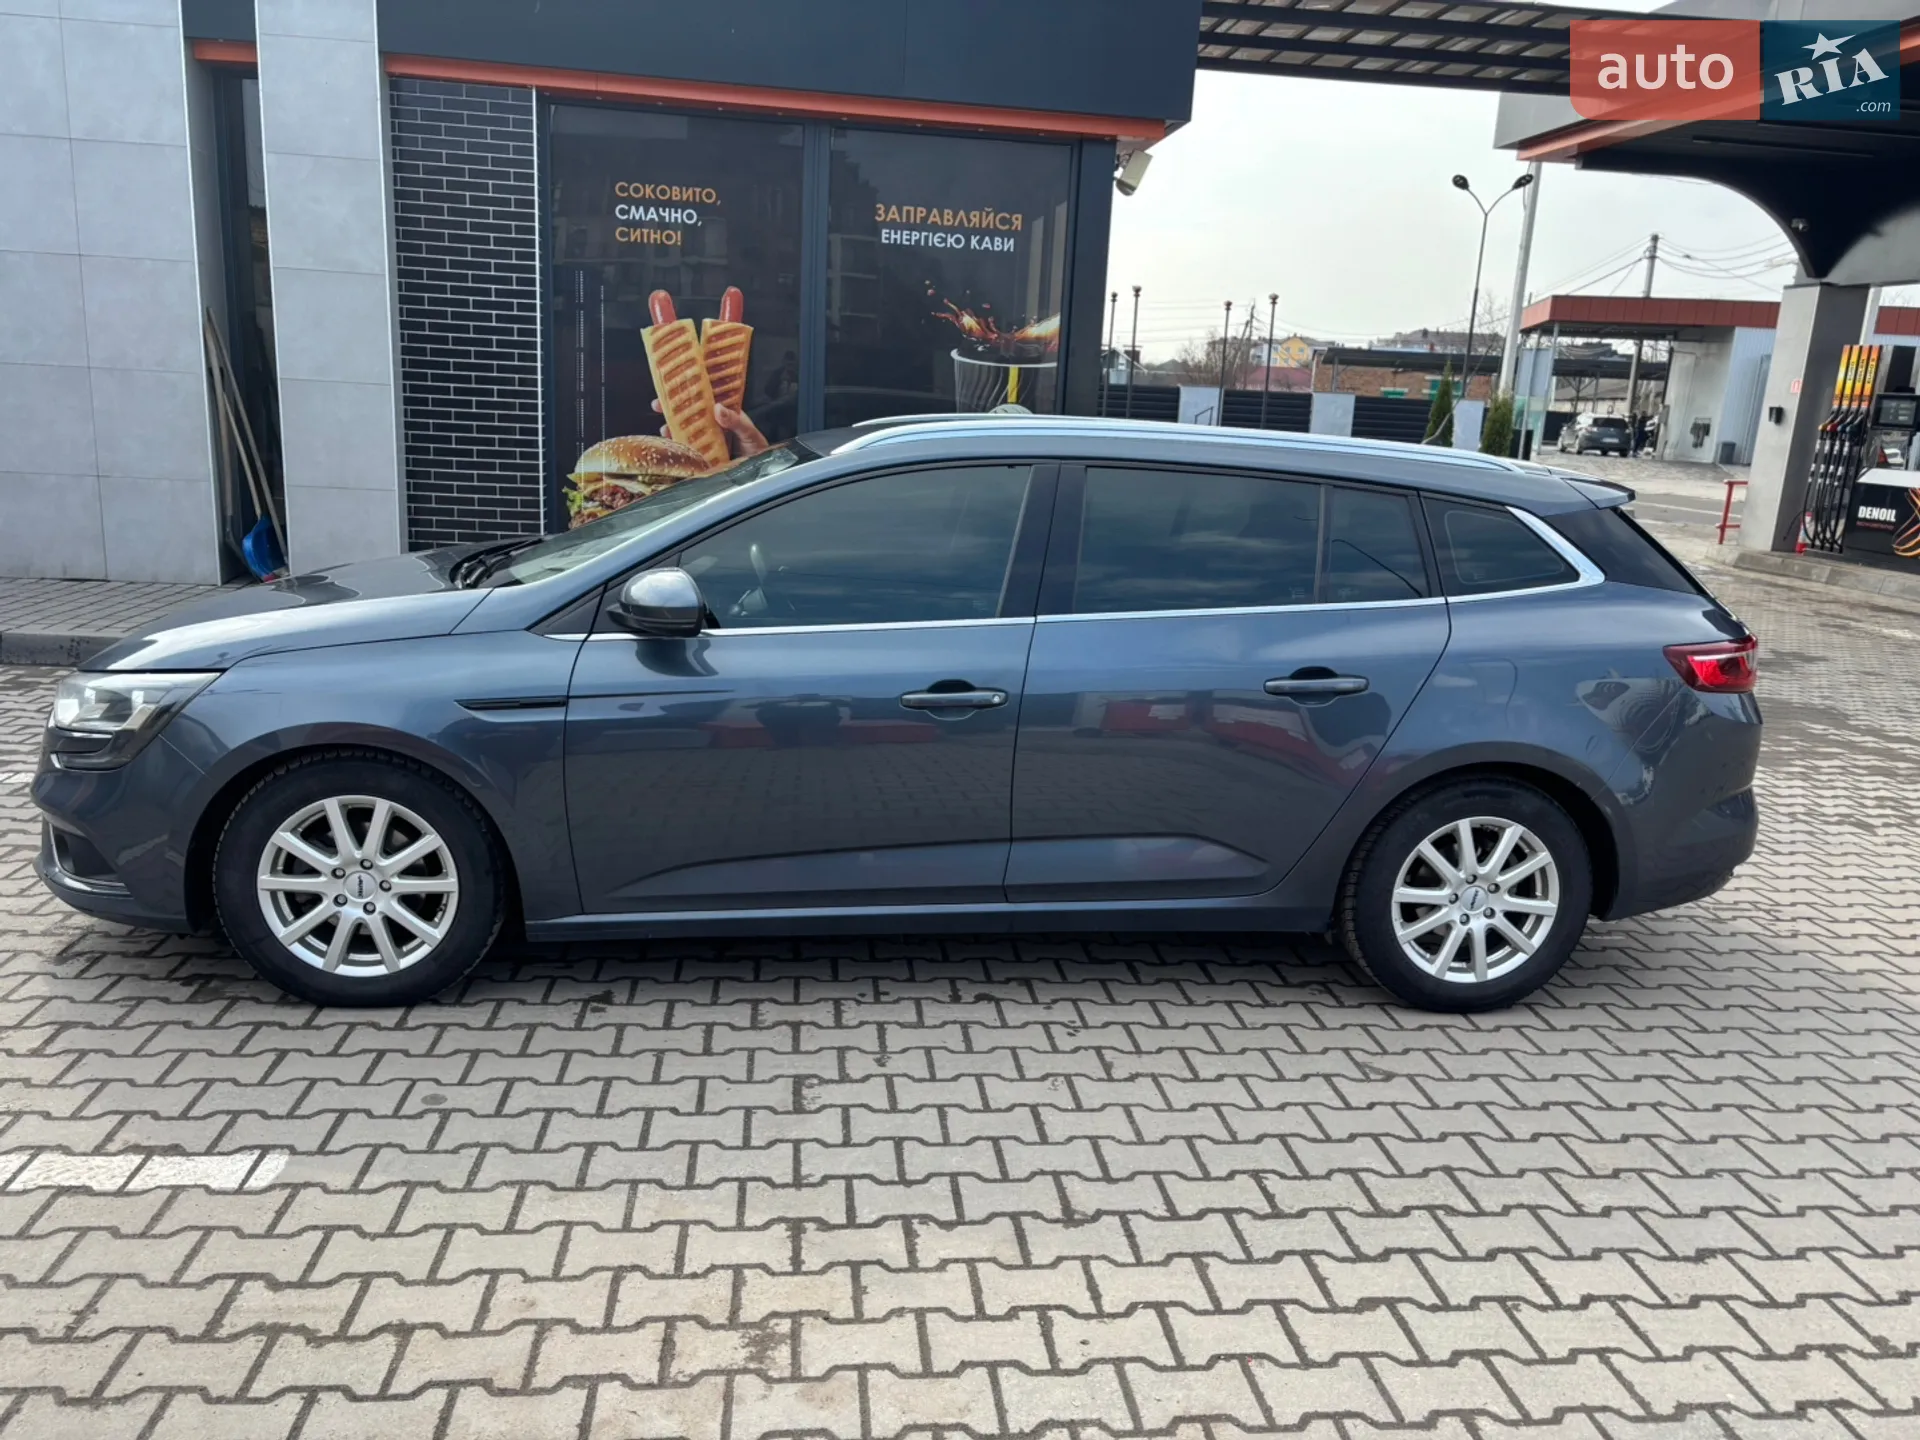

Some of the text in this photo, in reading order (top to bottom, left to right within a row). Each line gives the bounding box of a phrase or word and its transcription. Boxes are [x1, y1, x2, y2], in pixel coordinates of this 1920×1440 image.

[614, 181, 721, 206] СОКОВИТО,
[614, 204, 702, 227] СМАЧНО,
[874, 202, 1023, 232] ЗАПРАВЛЯЙСЯ
[614, 226, 682, 246] СИТНО!
[880, 228, 1015, 252] ЕНЕРГІЄЮ КАВИ
[1857, 505, 1897, 523] DENOIL
